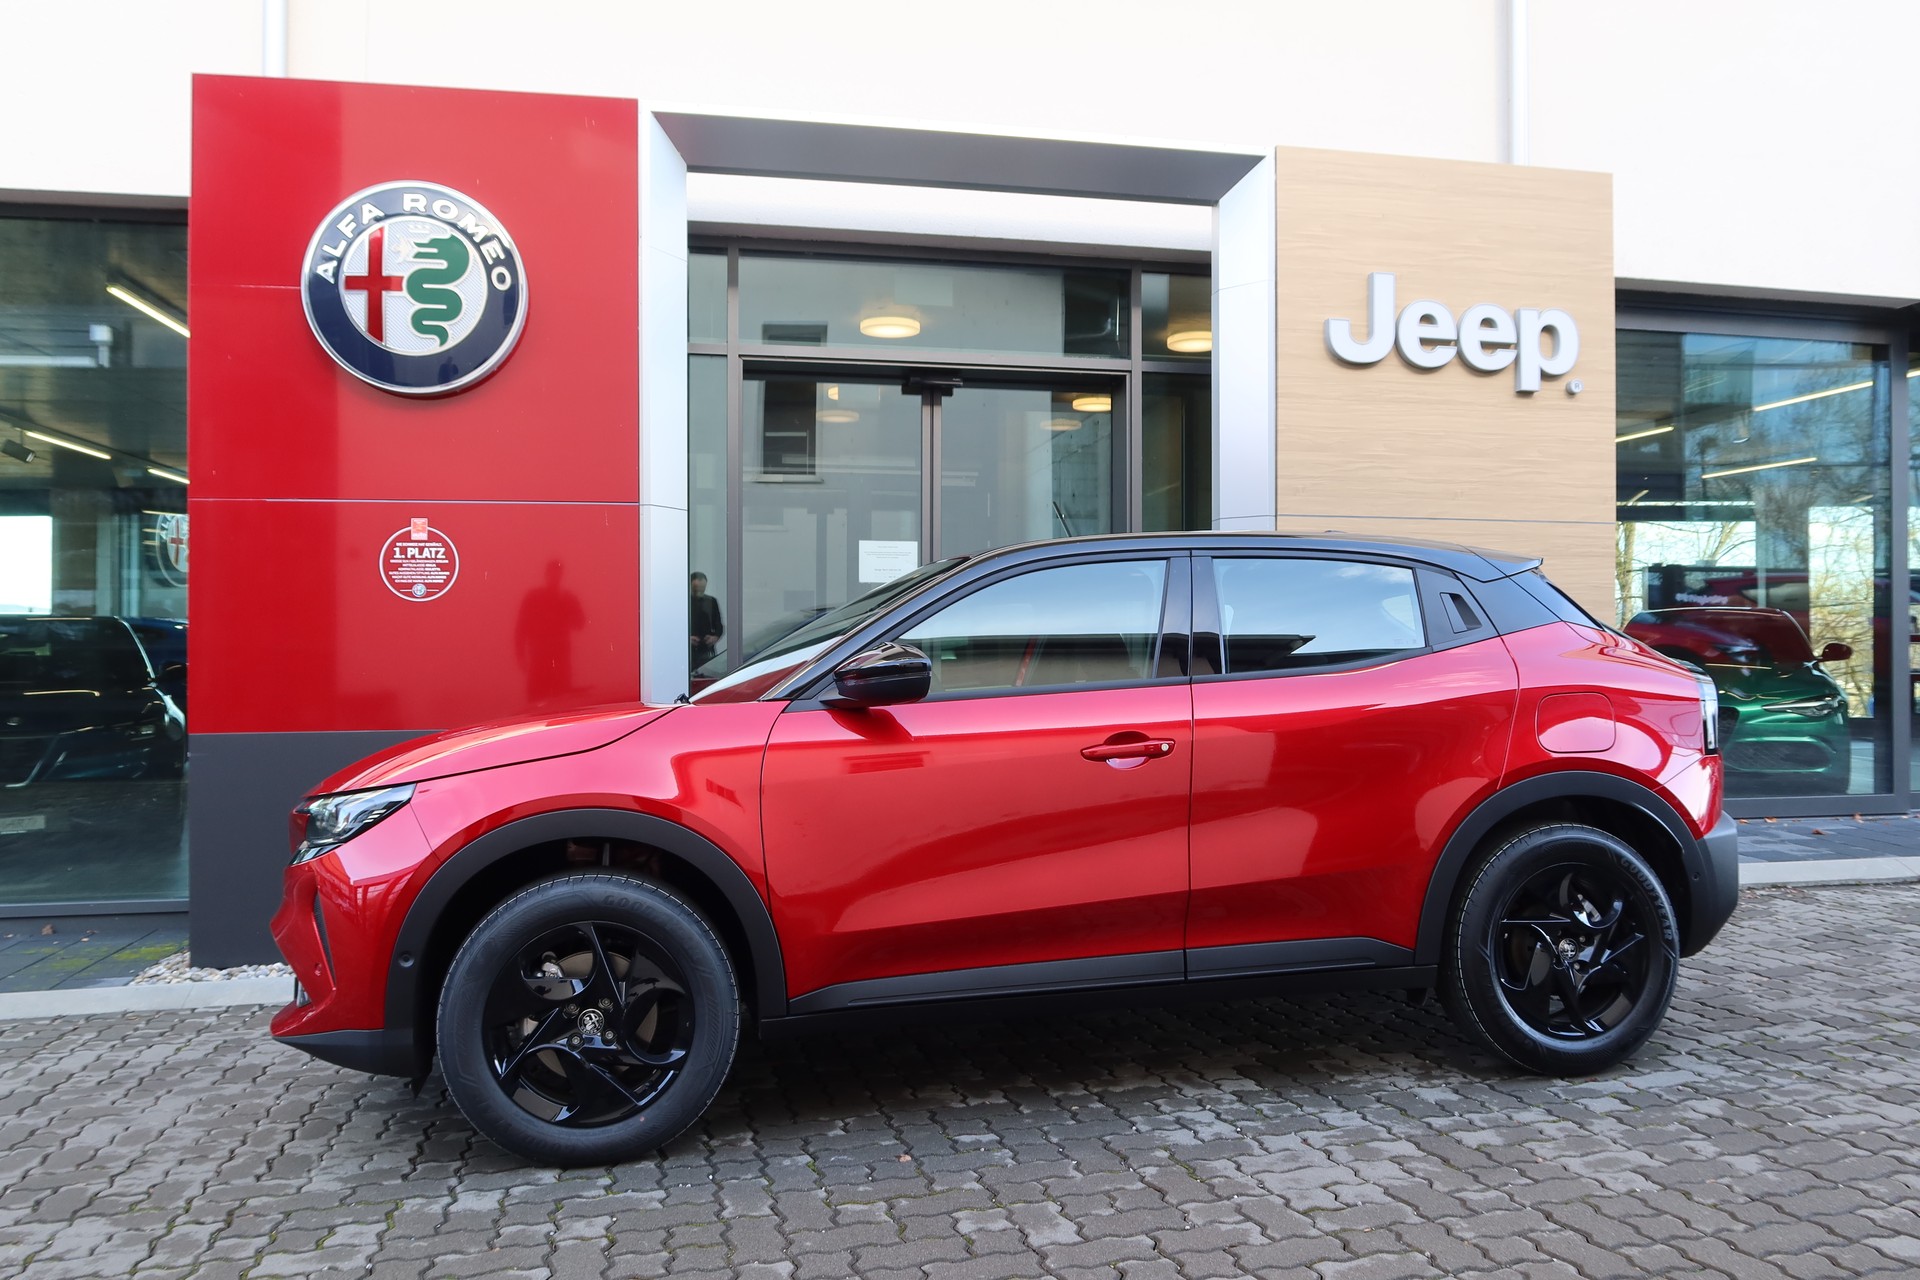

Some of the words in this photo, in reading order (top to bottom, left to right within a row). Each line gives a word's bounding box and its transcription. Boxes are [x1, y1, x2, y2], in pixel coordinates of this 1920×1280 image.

[316, 202, 385, 284] ALFA
[403, 193, 511, 291] ROMEO
[1323, 271, 1580, 393] Jeep
[393, 547, 405, 558] 1.
[407, 547, 445, 558] PLATZ
